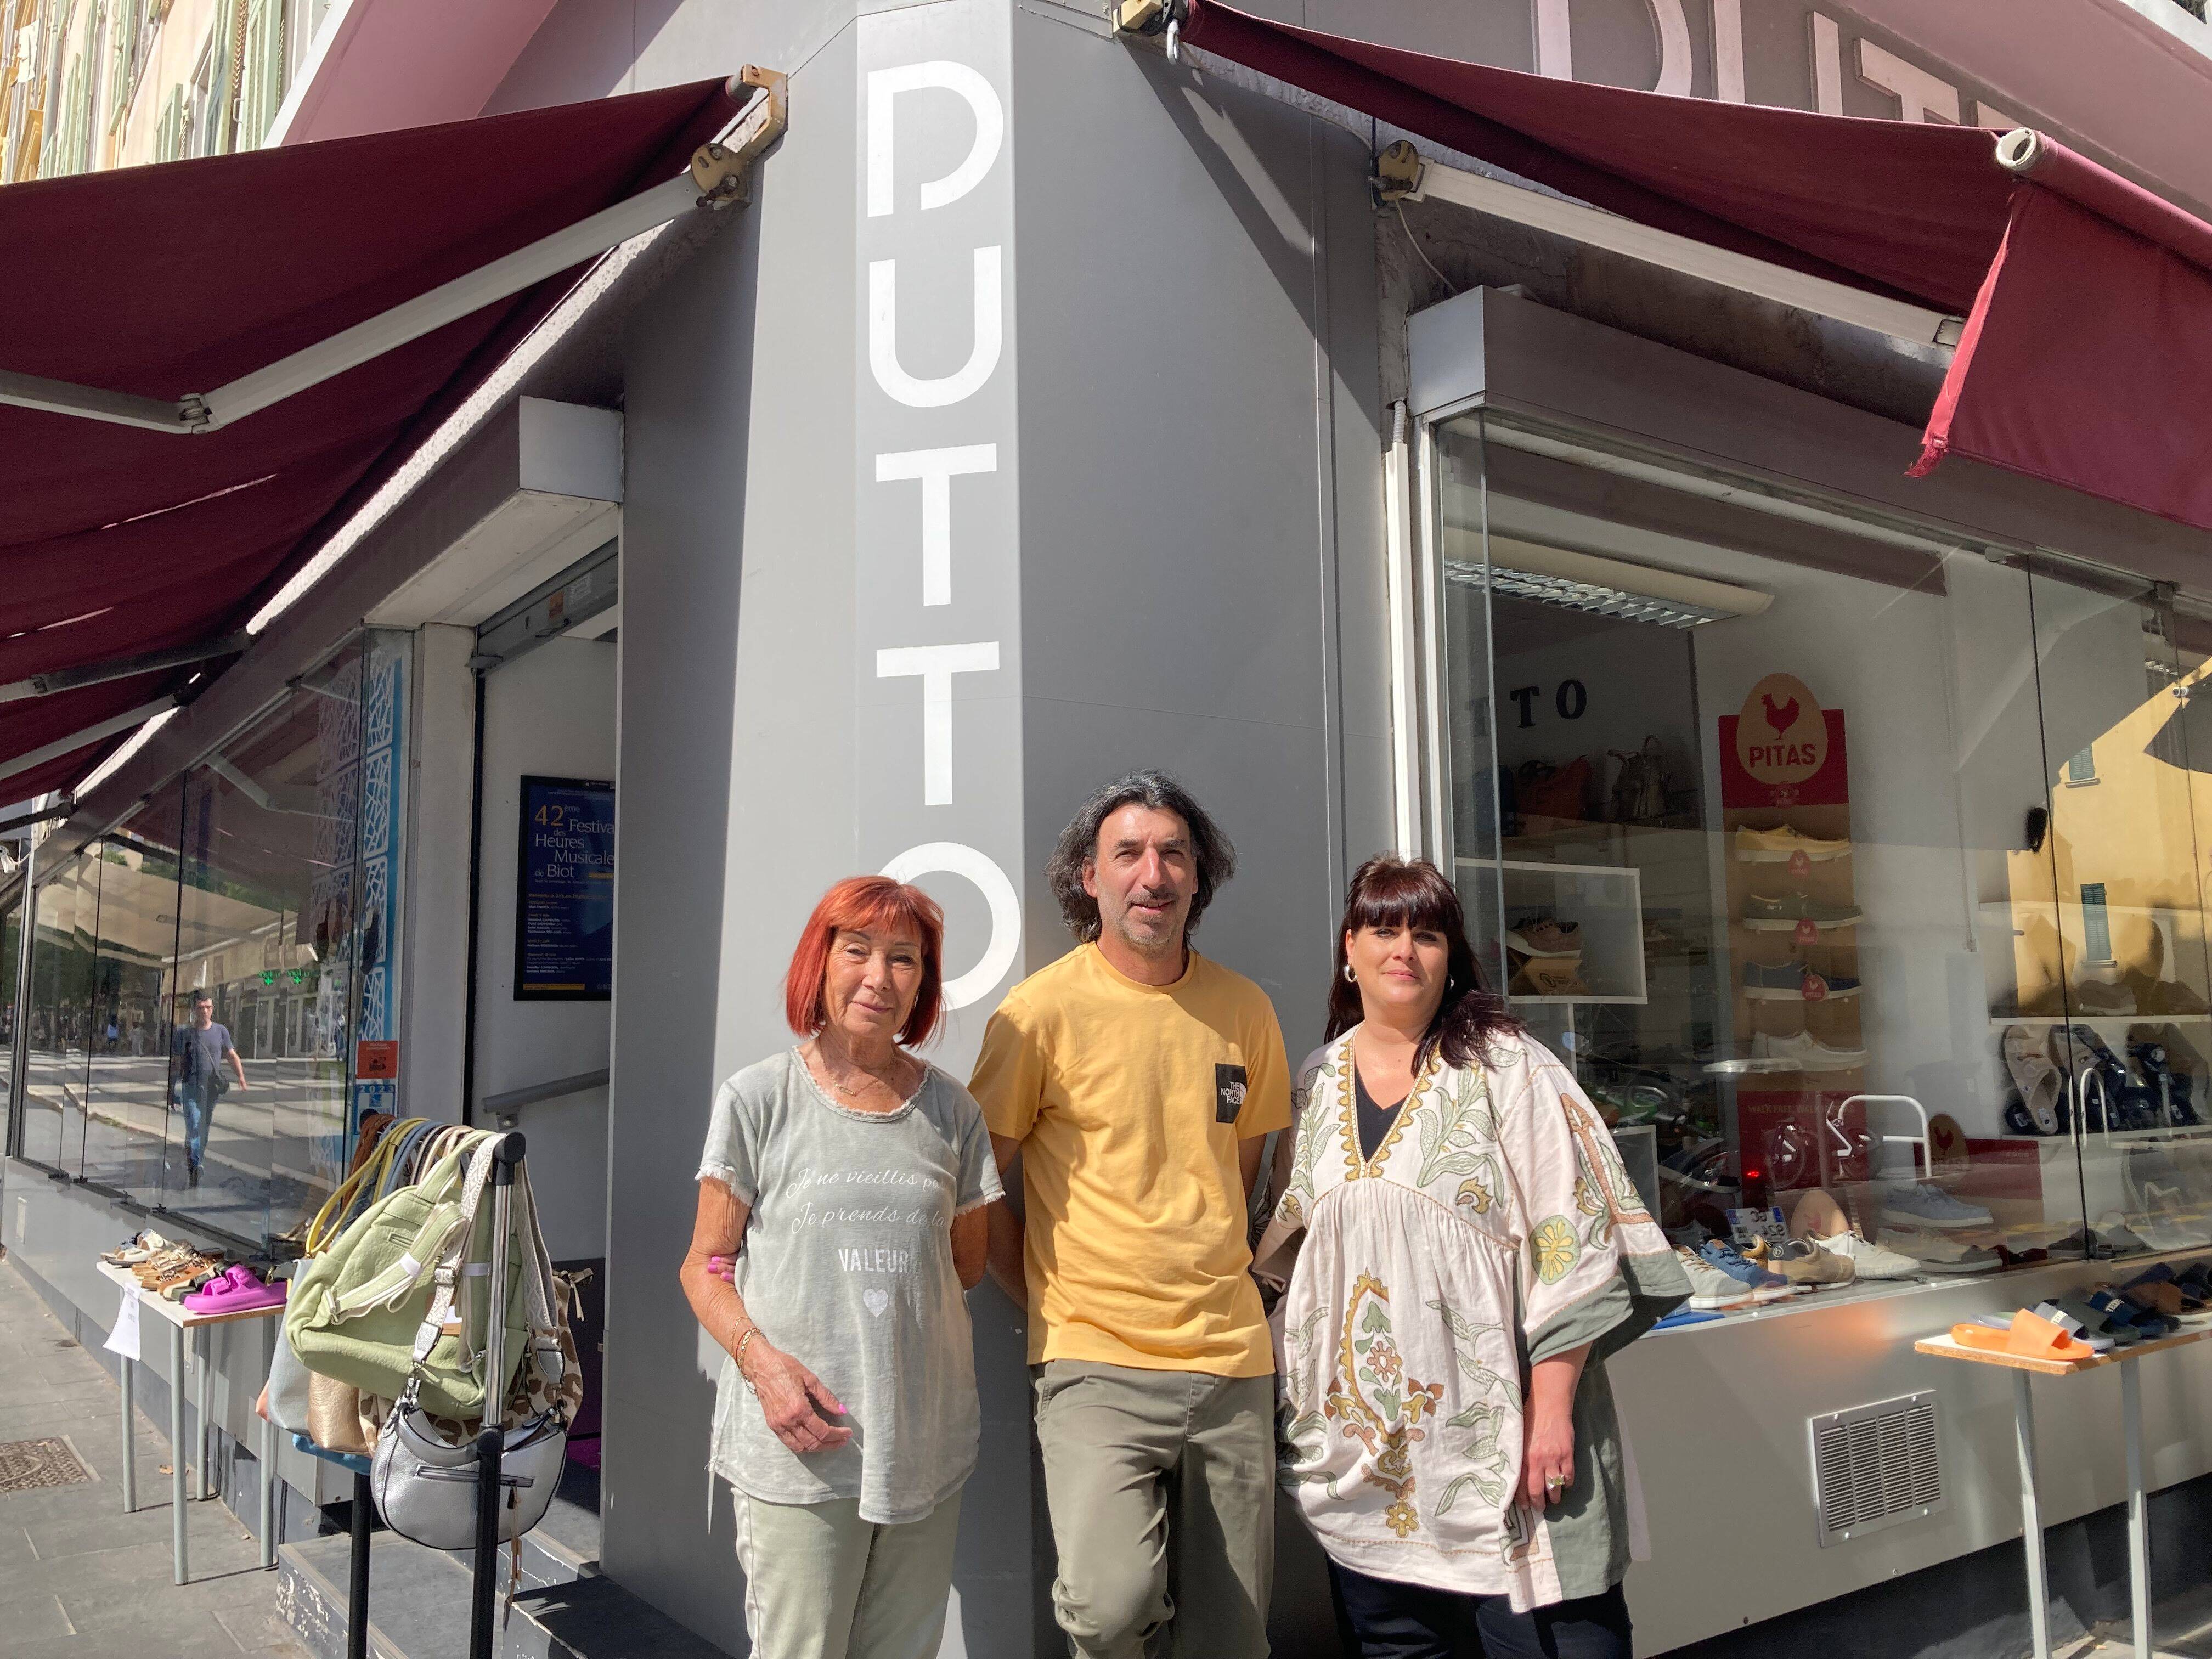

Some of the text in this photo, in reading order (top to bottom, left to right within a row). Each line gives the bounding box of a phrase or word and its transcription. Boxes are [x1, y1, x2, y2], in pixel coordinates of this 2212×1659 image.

[867, 60, 1021, 1012] PUTTO
[1749, 743, 1816, 768] PITAS
[535, 833, 585, 849] Heures
[534, 868, 545, 877] de
[547, 864, 575, 878] Biot
[1221, 1087, 1240, 1097] NORTH
[1229, 1081, 1240, 1090] THE
[1227, 1096, 1240, 1104] FACE
[786, 1167, 811, 1198] Je
[816, 1172, 839, 1186] ne
[846, 1169, 918, 1185] vieillis
[792, 1201, 945, 1234] Je prends de la
[838, 1248, 909, 1273] VALEUR
